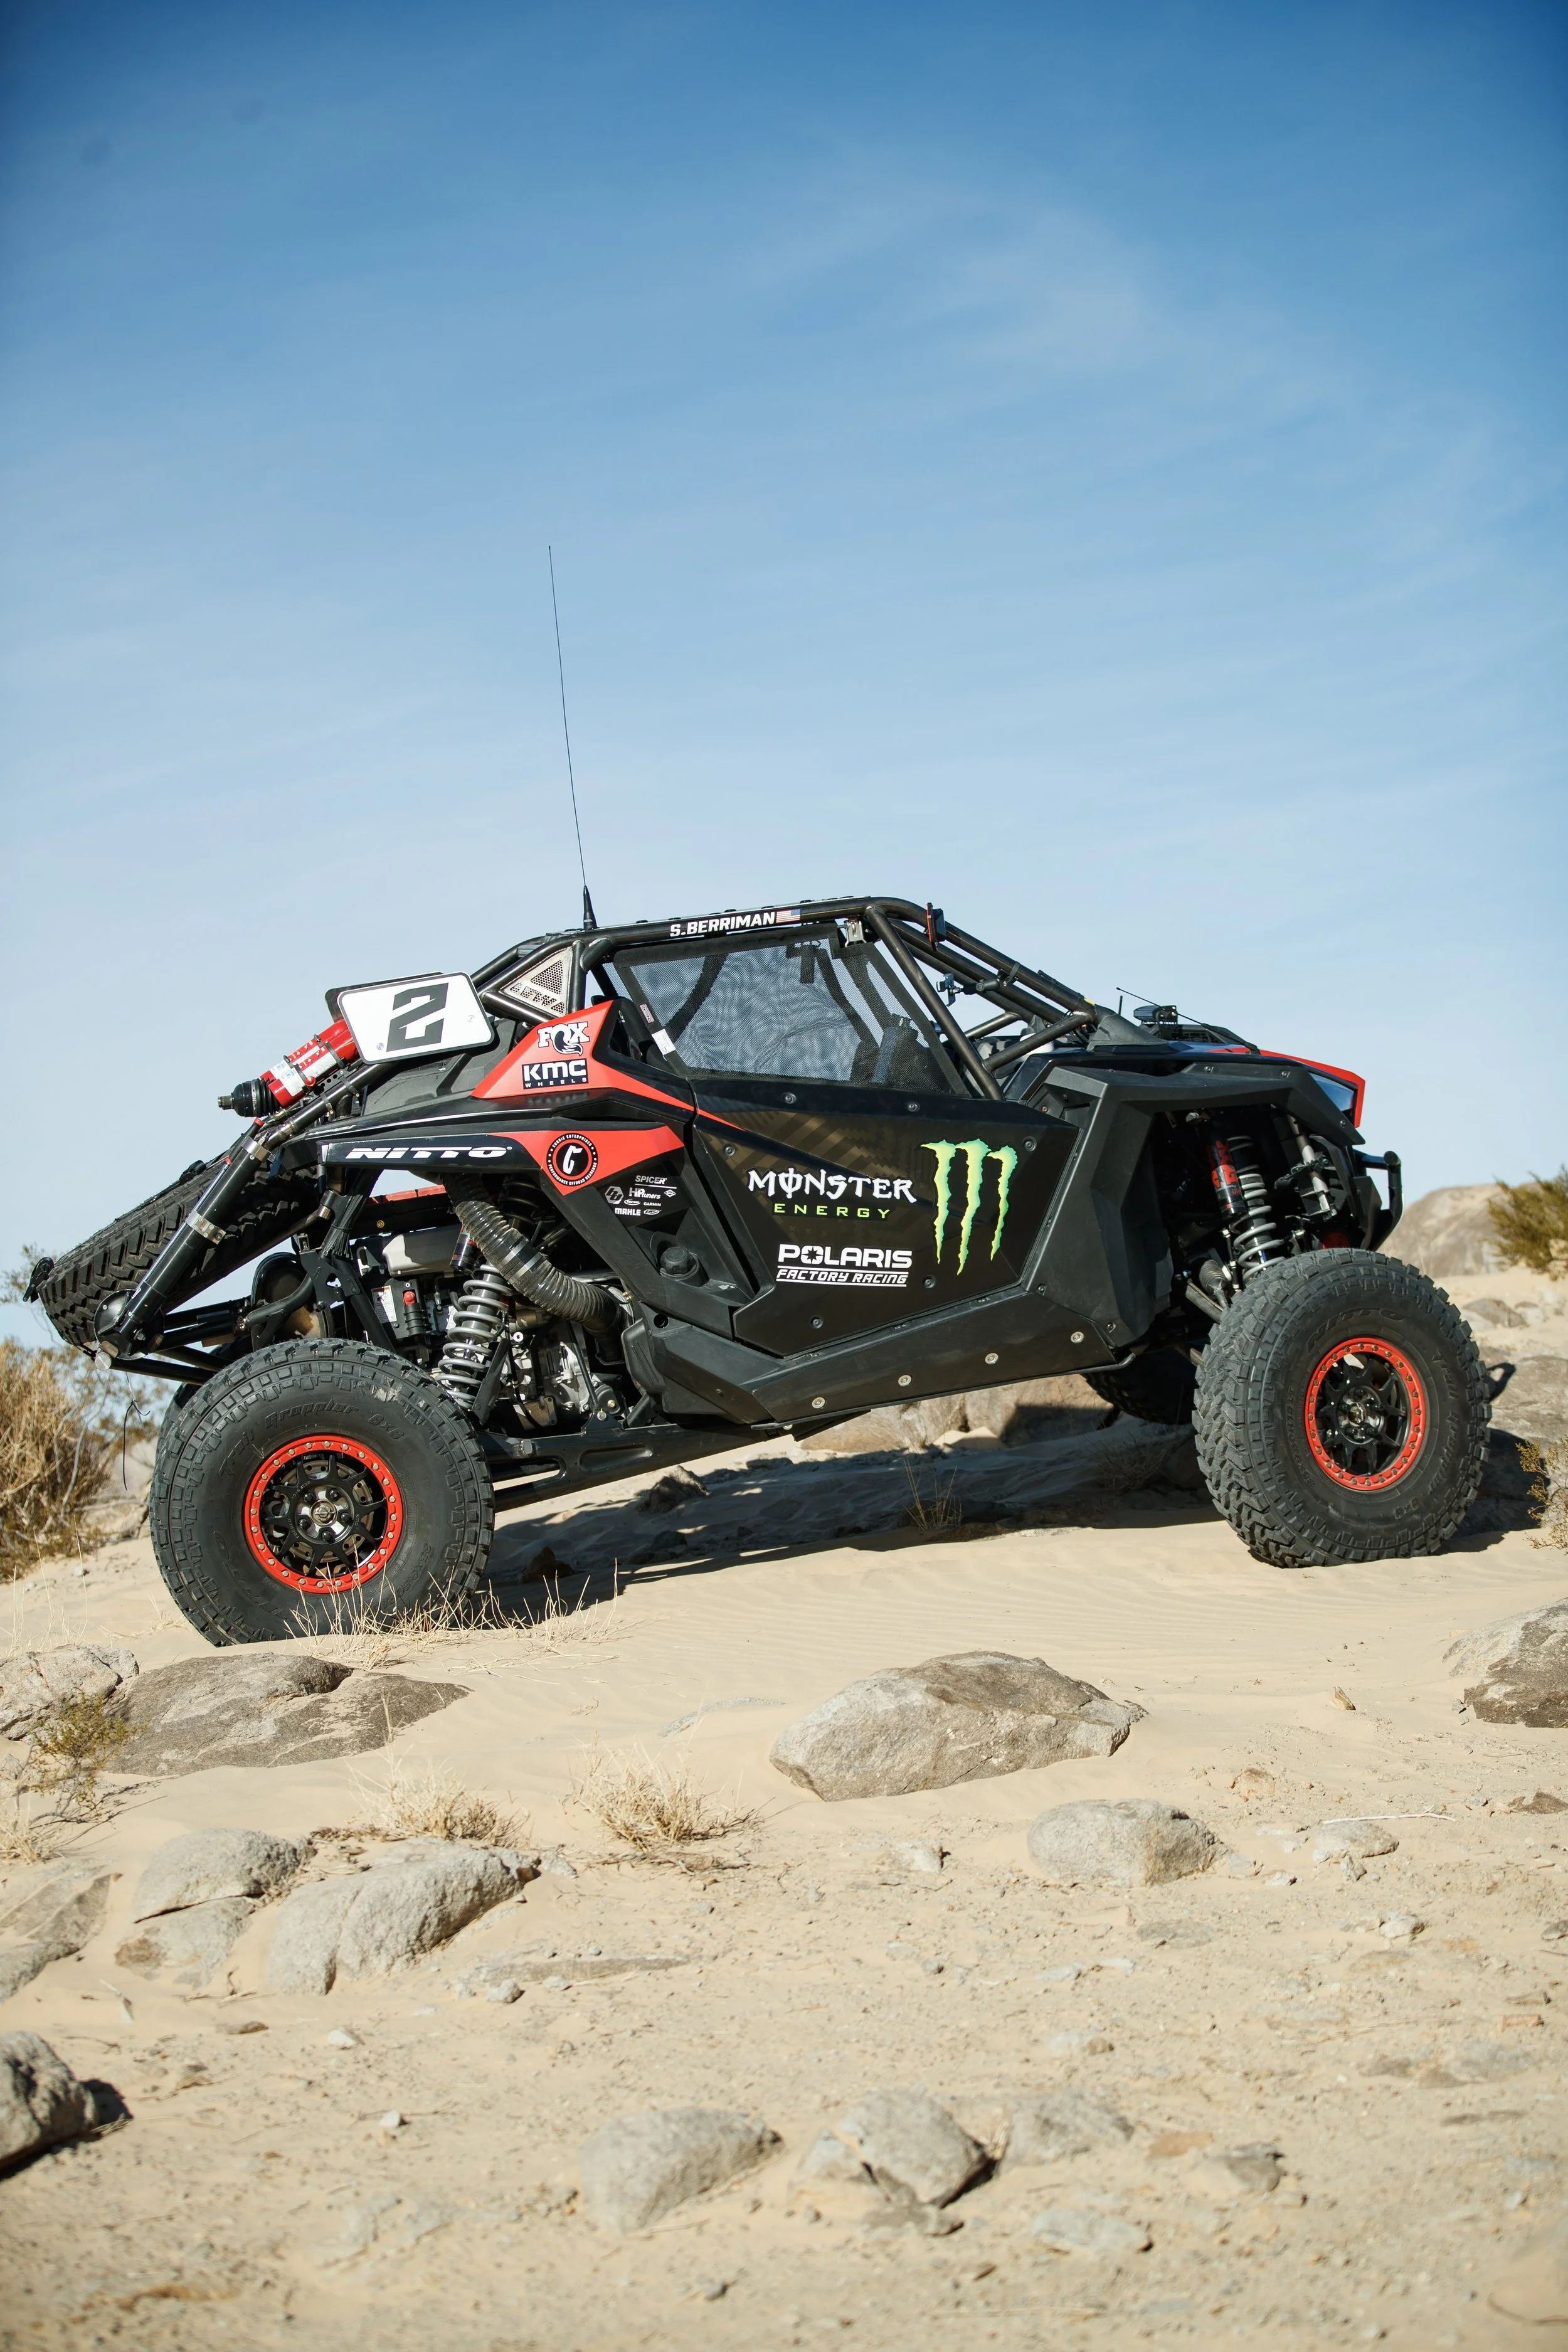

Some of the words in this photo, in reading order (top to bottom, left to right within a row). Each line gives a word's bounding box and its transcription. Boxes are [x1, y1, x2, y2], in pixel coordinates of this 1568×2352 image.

[670, 912, 775, 937] S.BERRIMAN
[386, 983, 448, 1052] 2
[538, 1022, 590, 1055] FOX
[526, 1078, 587, 1088] WHEELS
[635, 1175, 665, 1185] SPICER
[748, 1168, 916, 1203] MONSTER
[615, 1207, 641, 1216] MAHLE
[774, 1204, 890, 1218] ENERGY
[778, 1244, 912, 1268] POLARIS
[777, 1269, 849, 1281] FACTORY
[852, 1274, 908, 1283] RACING
